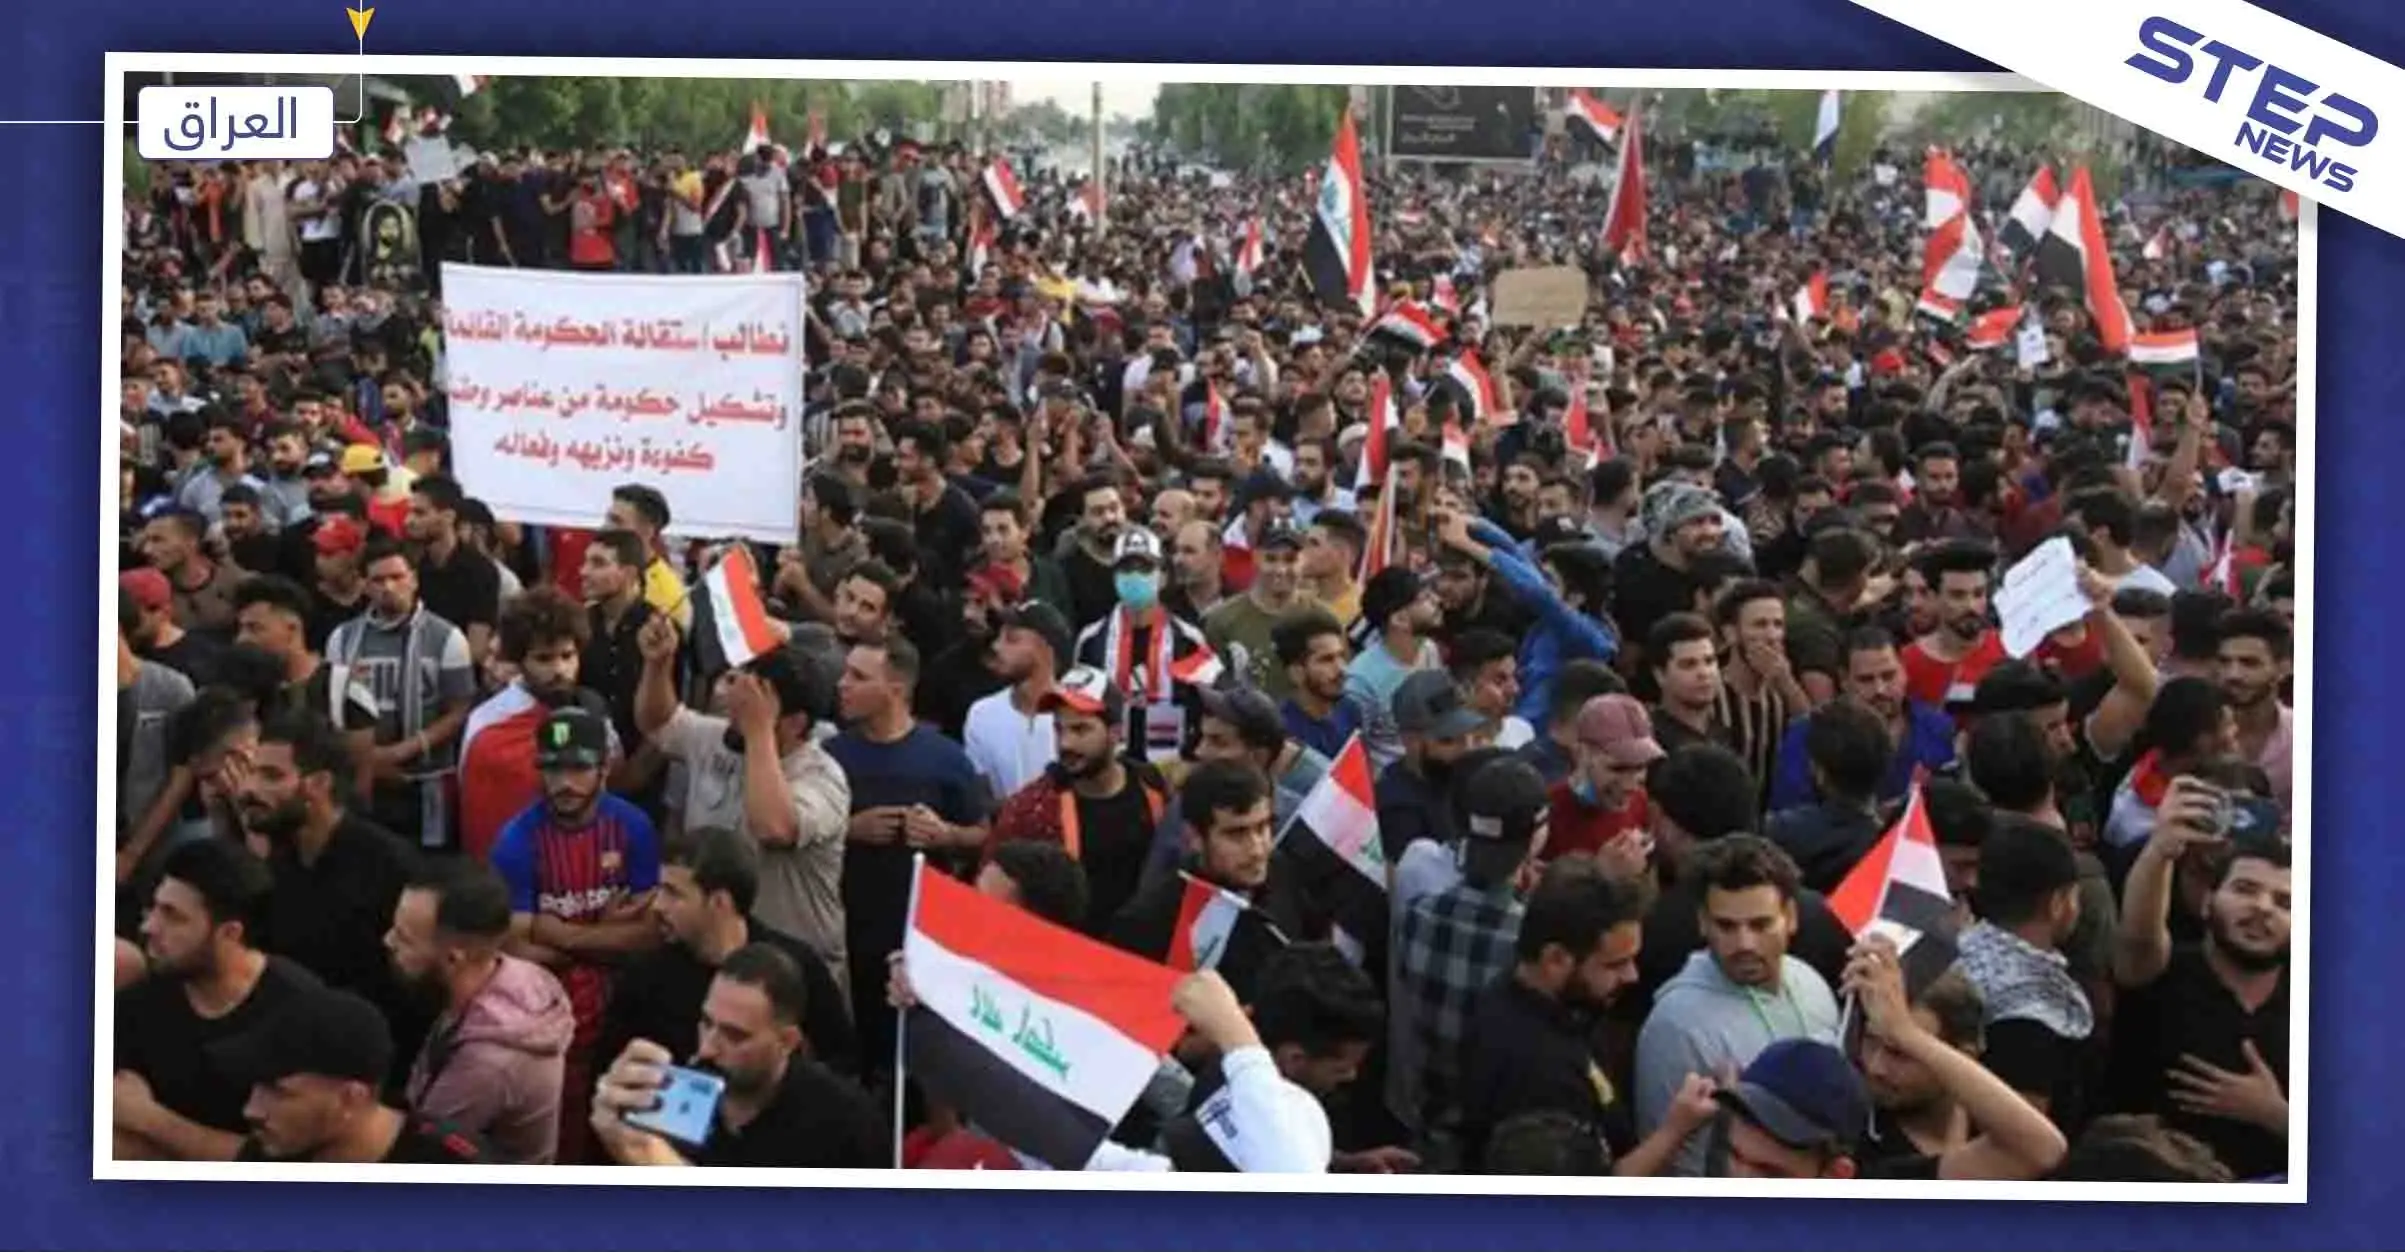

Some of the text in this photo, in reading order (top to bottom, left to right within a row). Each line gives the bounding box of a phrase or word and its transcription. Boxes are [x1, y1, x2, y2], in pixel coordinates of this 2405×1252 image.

[514, 310, 618, 353] الحكومة
[713, 320, 790, 360] نطالب
[560, 385, 589, 418] من
[596, 383, 680, 421] حكومة
[687, 386, 787, 430] وتشكيل
